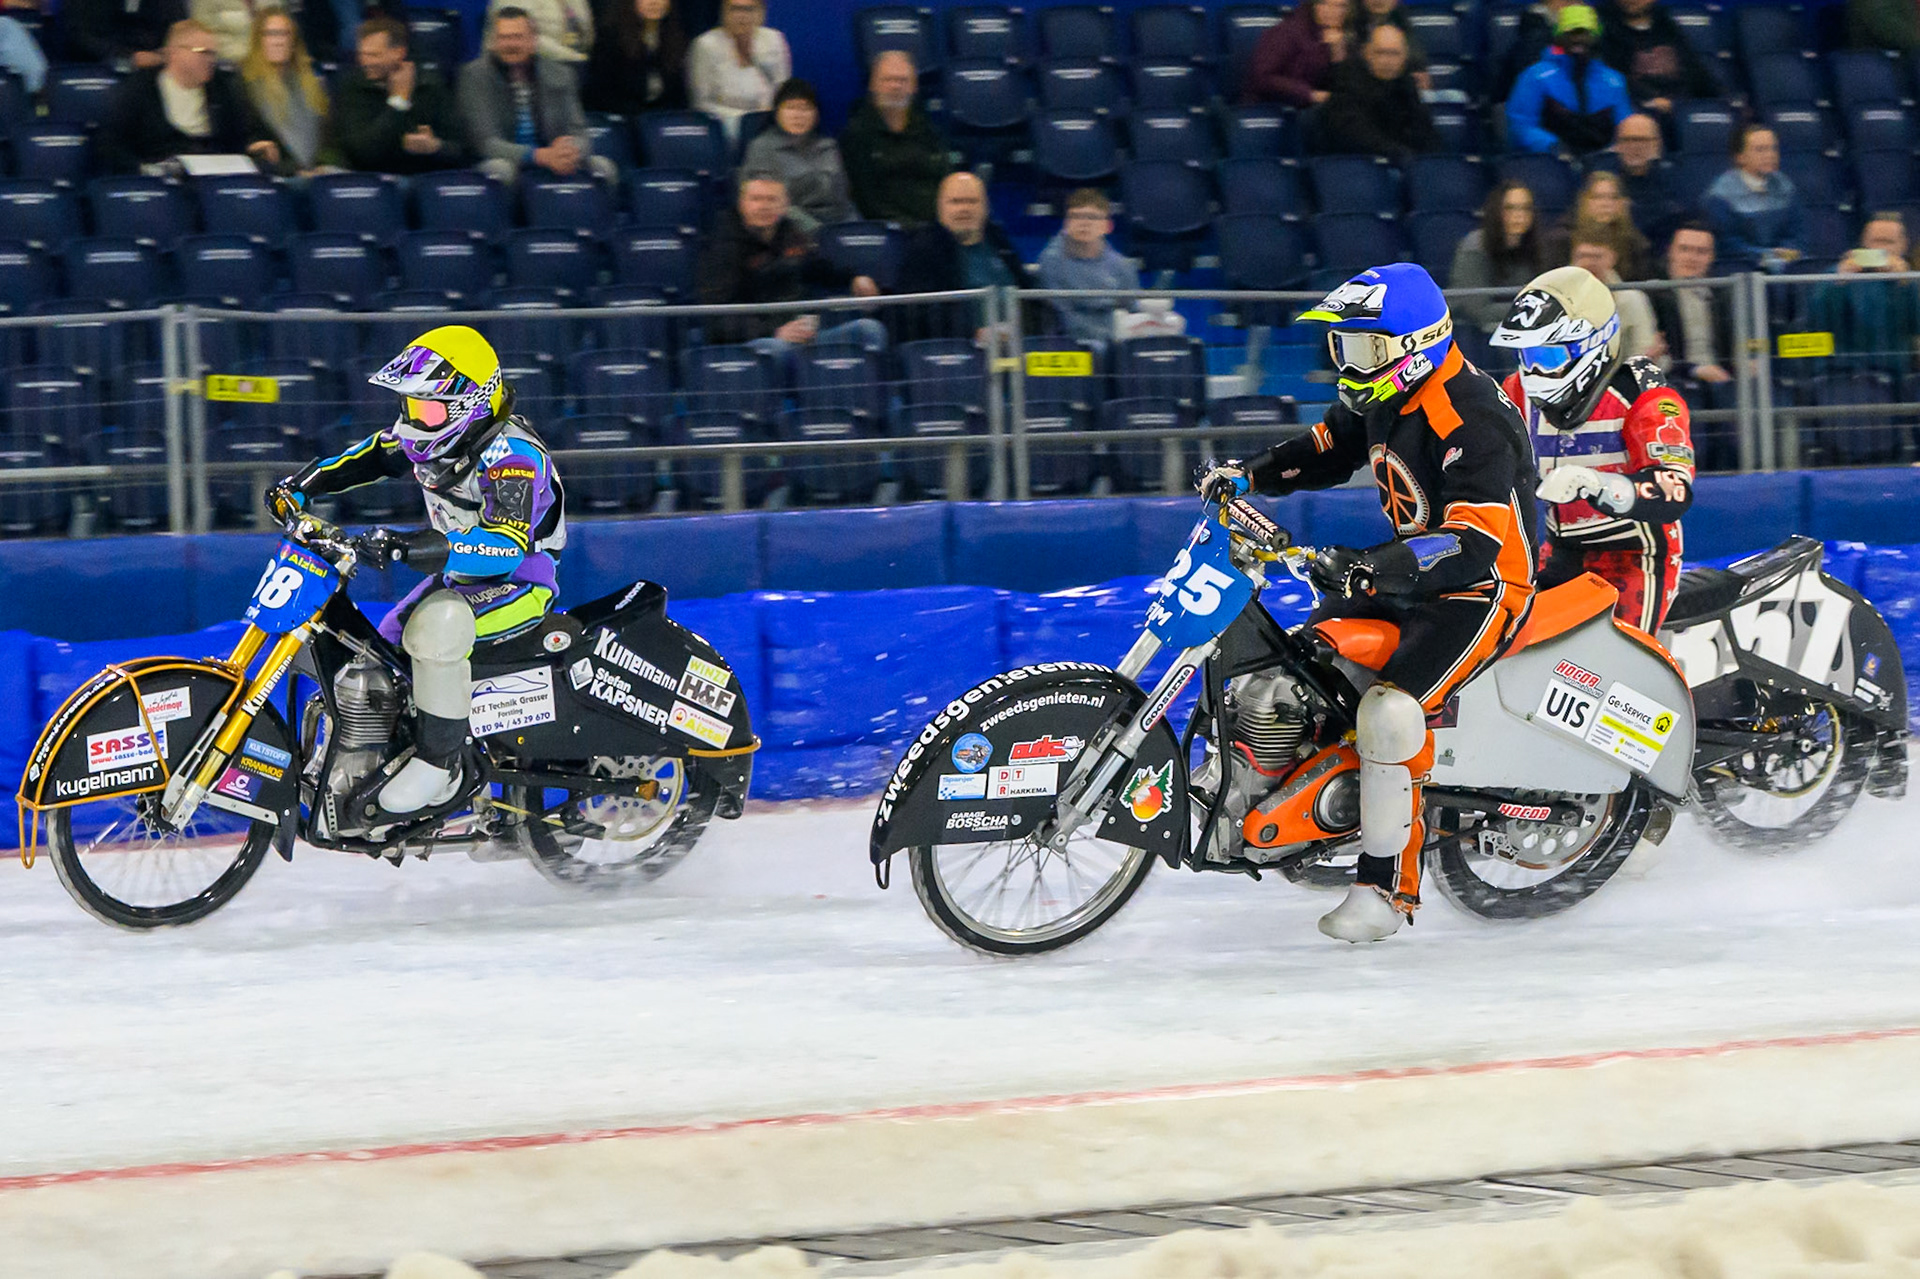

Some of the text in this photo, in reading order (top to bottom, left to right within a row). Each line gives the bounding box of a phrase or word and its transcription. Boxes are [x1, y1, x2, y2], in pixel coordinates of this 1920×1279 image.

[1233, 499, 1278, 533] RENTHAL
[288, 553, 328, 578] Alztal
[1159, 548, 1236, 617] 25
[595, 667, 632, 693] Stefan
[680, 674, 733, 709] H&F
[471, 692, 549, 715] KFZ Technik Grasser
[497, 707, 523, 719] Forsting
[589, 679, 669, 728] KAPSNER
[979, 691, 1106, 733] zweedsgenieten.nl
[1546, 687, 1590, 728] UIS
[494, 720, 505, 730] 94
[535, 711, 551, 720] 670
[90, 729, 164, 757] SASSE
[91, 746, 165, 765] www.sasse-bad.e
[55, 766, 155, 797] kugelmann
[1010, 786, 1048, 795] HARKEMA
[945, 815, 1009, 830] BOSSCHA
[951, 811, 985, 819] GARAGE
